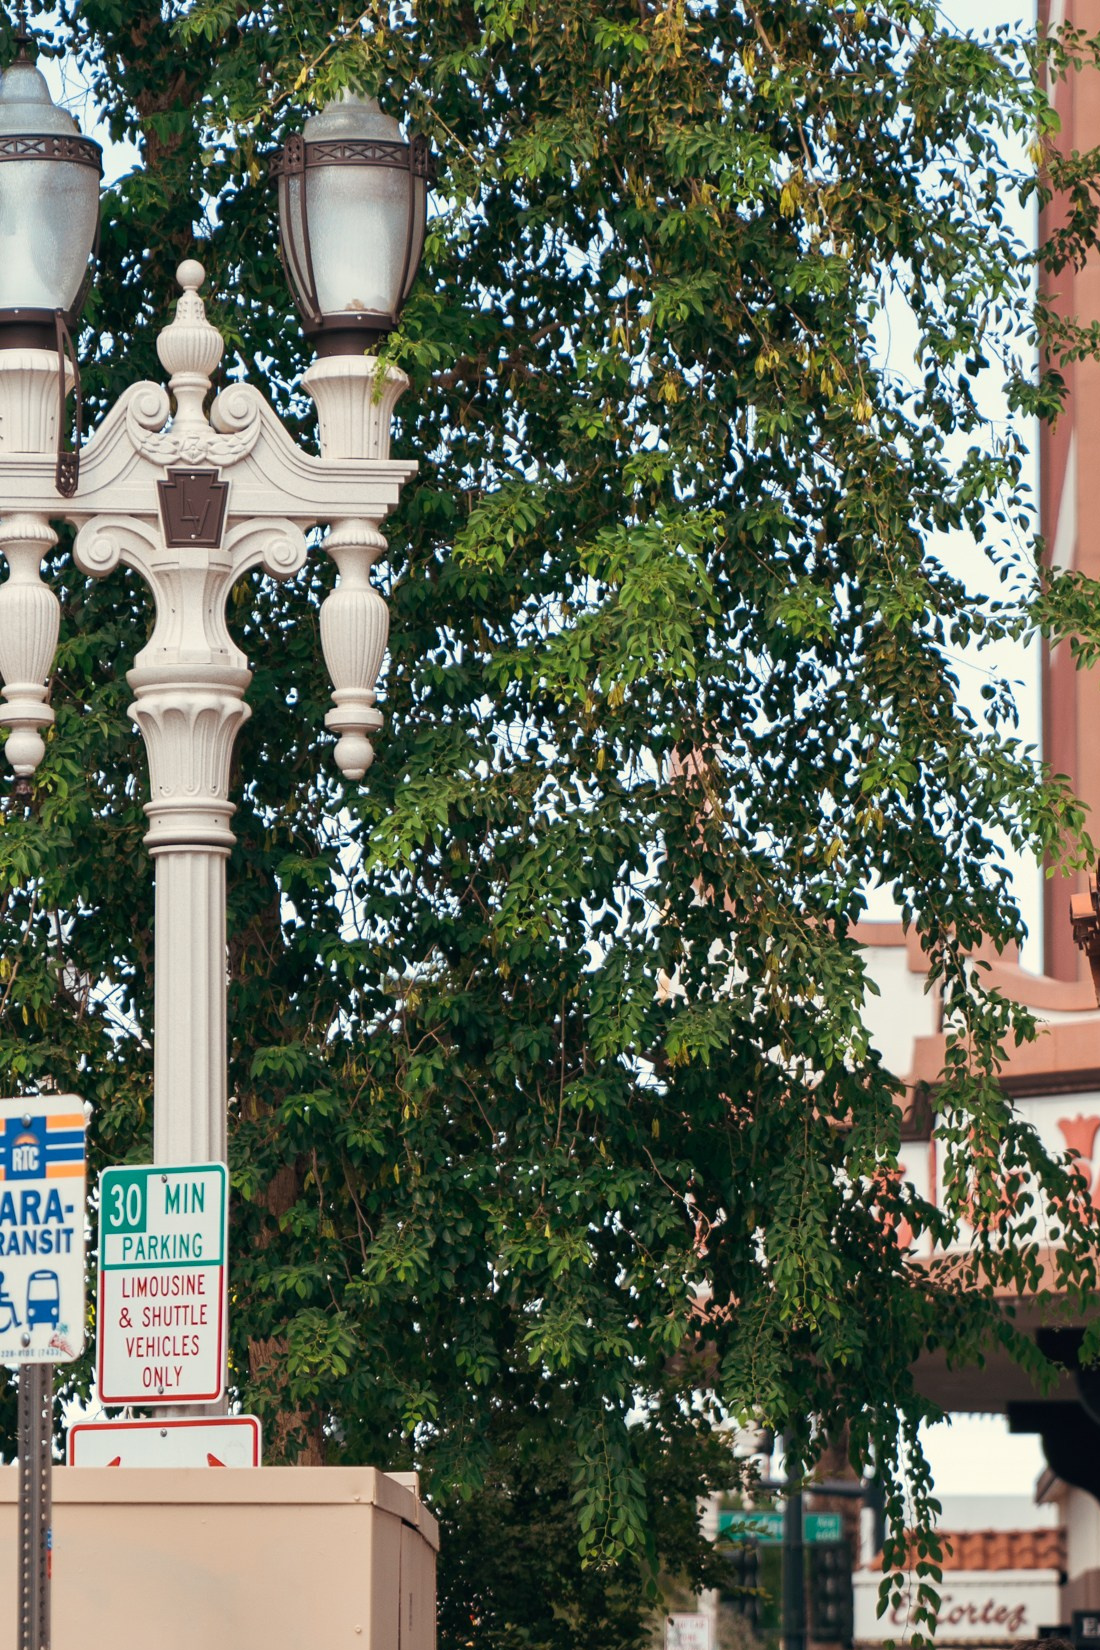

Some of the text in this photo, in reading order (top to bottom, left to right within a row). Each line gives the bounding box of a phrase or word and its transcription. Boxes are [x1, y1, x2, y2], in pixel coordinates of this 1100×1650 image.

[12, 1146, 39, 1171] RTC
[109, 1182, 205, 1227] 30 MIN
[122, 1232, 203, 1261] PARKING
[122, 1274, 205, 1298] LIMOUSINE
[119, 1304, 207, 1328] & SHUTTLE
[126, 1335, 199, 1358] VEHICLES
[143, 1366, 183, 1388] ONLY
